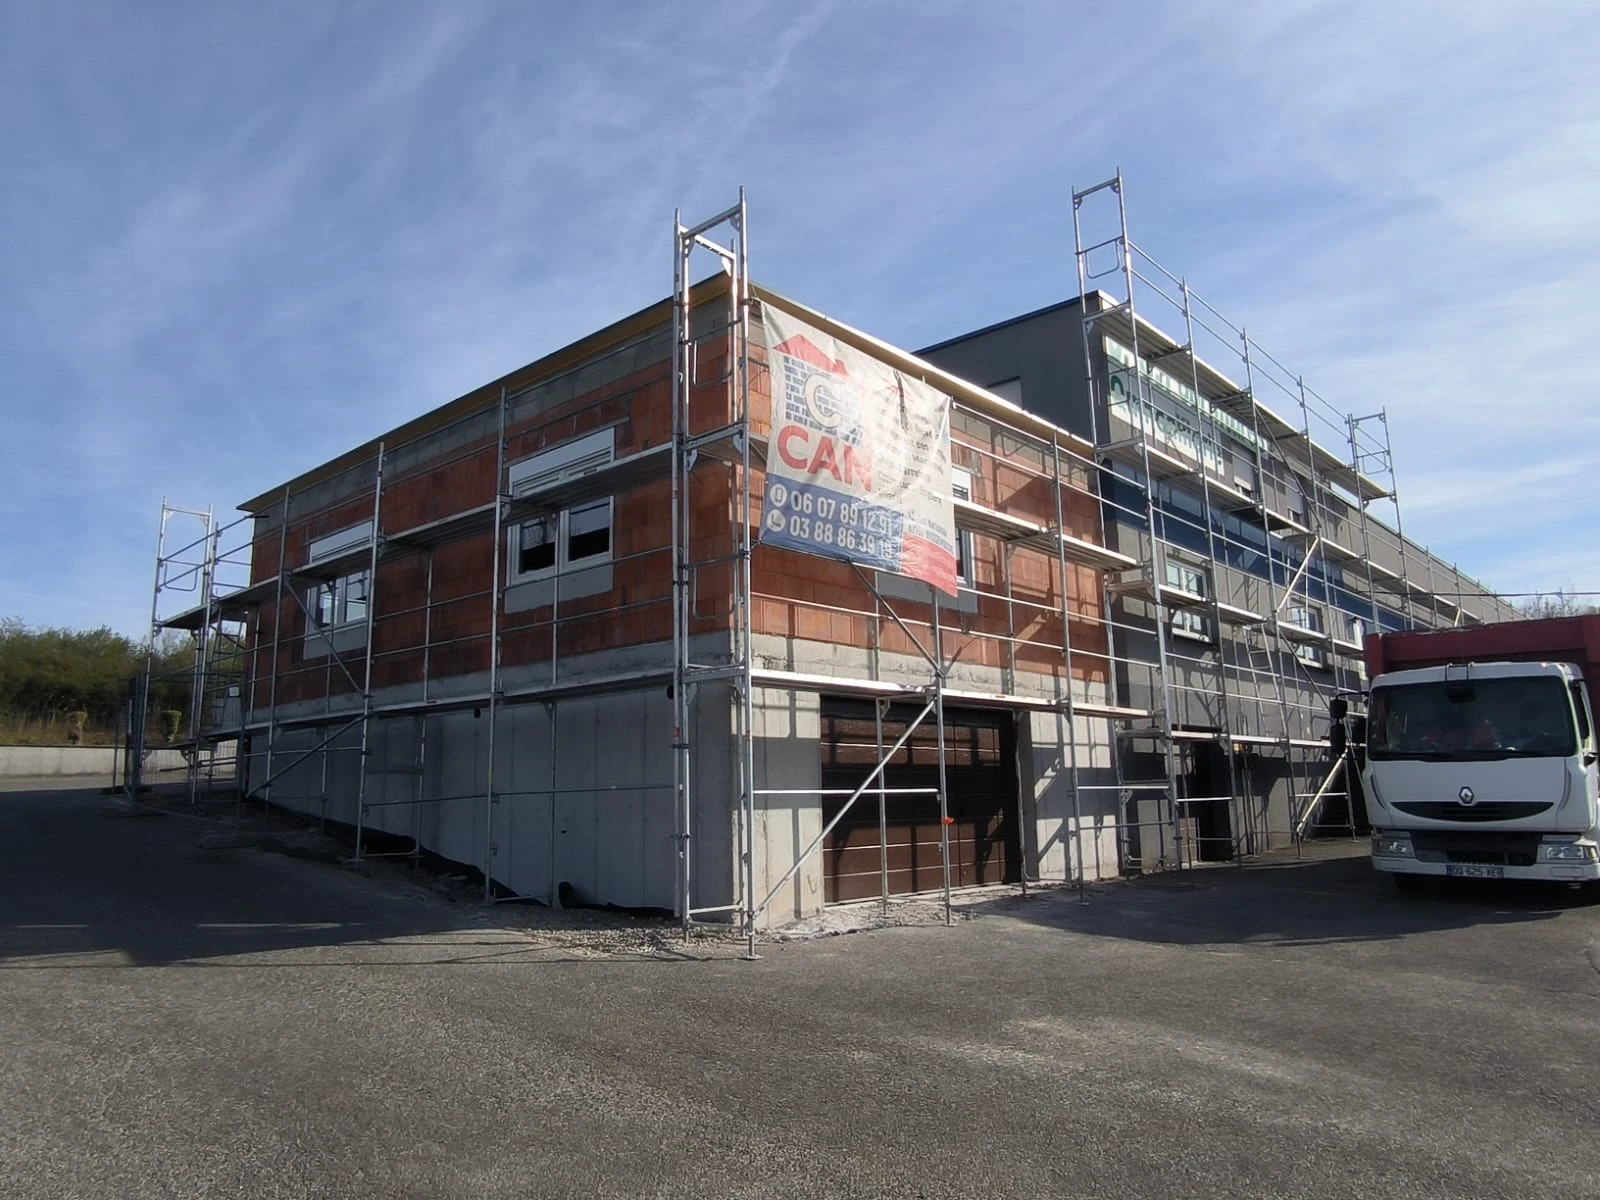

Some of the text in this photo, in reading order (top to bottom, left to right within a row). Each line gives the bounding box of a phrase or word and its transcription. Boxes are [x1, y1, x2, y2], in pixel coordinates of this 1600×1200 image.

[791, 490, 813, 514] 06
[817, 497, 836, 520] 07
[840, 502, 858, 526] 89
[862, 509, 876, 532] 12
[790, 515, 809, 538] 03
[814, 521, 833, 544] 88
[838, 526, 856, 550] 86
[858, 532, 875, 553] 39
